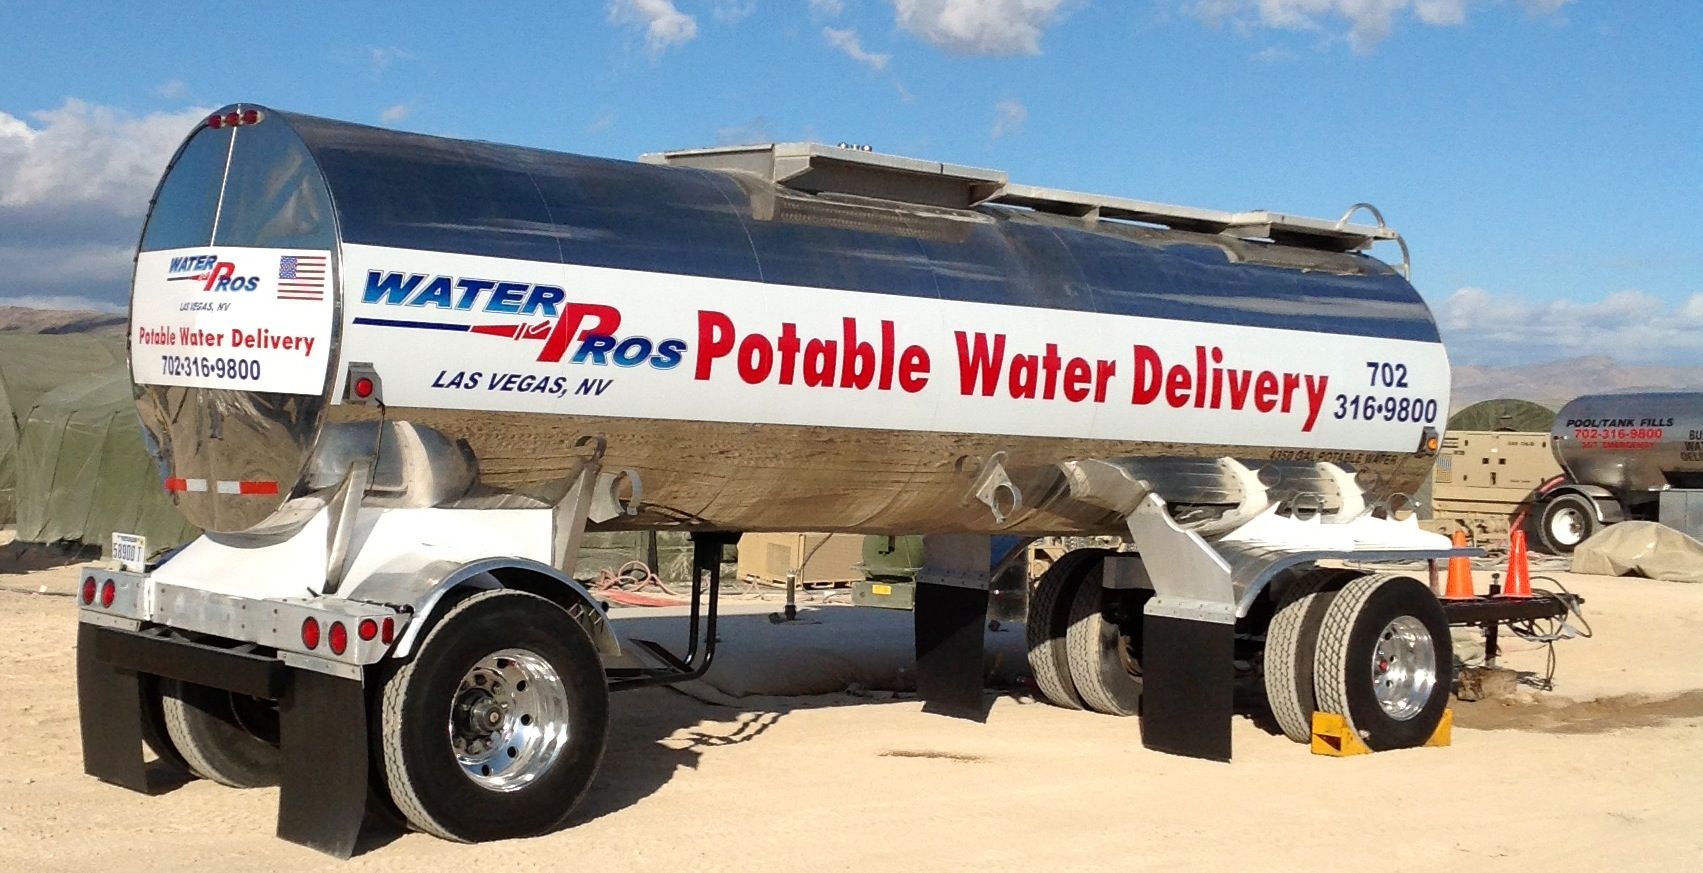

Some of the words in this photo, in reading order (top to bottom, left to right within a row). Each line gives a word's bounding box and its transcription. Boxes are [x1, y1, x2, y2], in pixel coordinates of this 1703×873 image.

[168, 254, 218, 273] WATER
[203, 261, 261, 292] PROS
[216, 302, 232, 311] NV
[361, 268, 567, 318] WATER
[139, 326, 176, 347] Potable
[179, 327, 224, 348] Water
[231, 328, 316, 357] Delivery
[535, 302, 689, 371] PROS
[431, 370, 484, 390] LAS
[486, 372, 571, 398] VEGAS,
[573, 378, 615, 397] NV
[694, 310, 932, 393] Potable
[954, 330, 1117, 404] Water
[1131, 344, 1330, 433] Delivery
[1366, 361, 1408, 389] 702
[1573, 427, 1664, 440] 702-316-9800
[1640, 418, 1675, 427] FILLS
[1317, 450, 1364, 464] POTABLE
[1365, 453, 1399, 465] WATER
